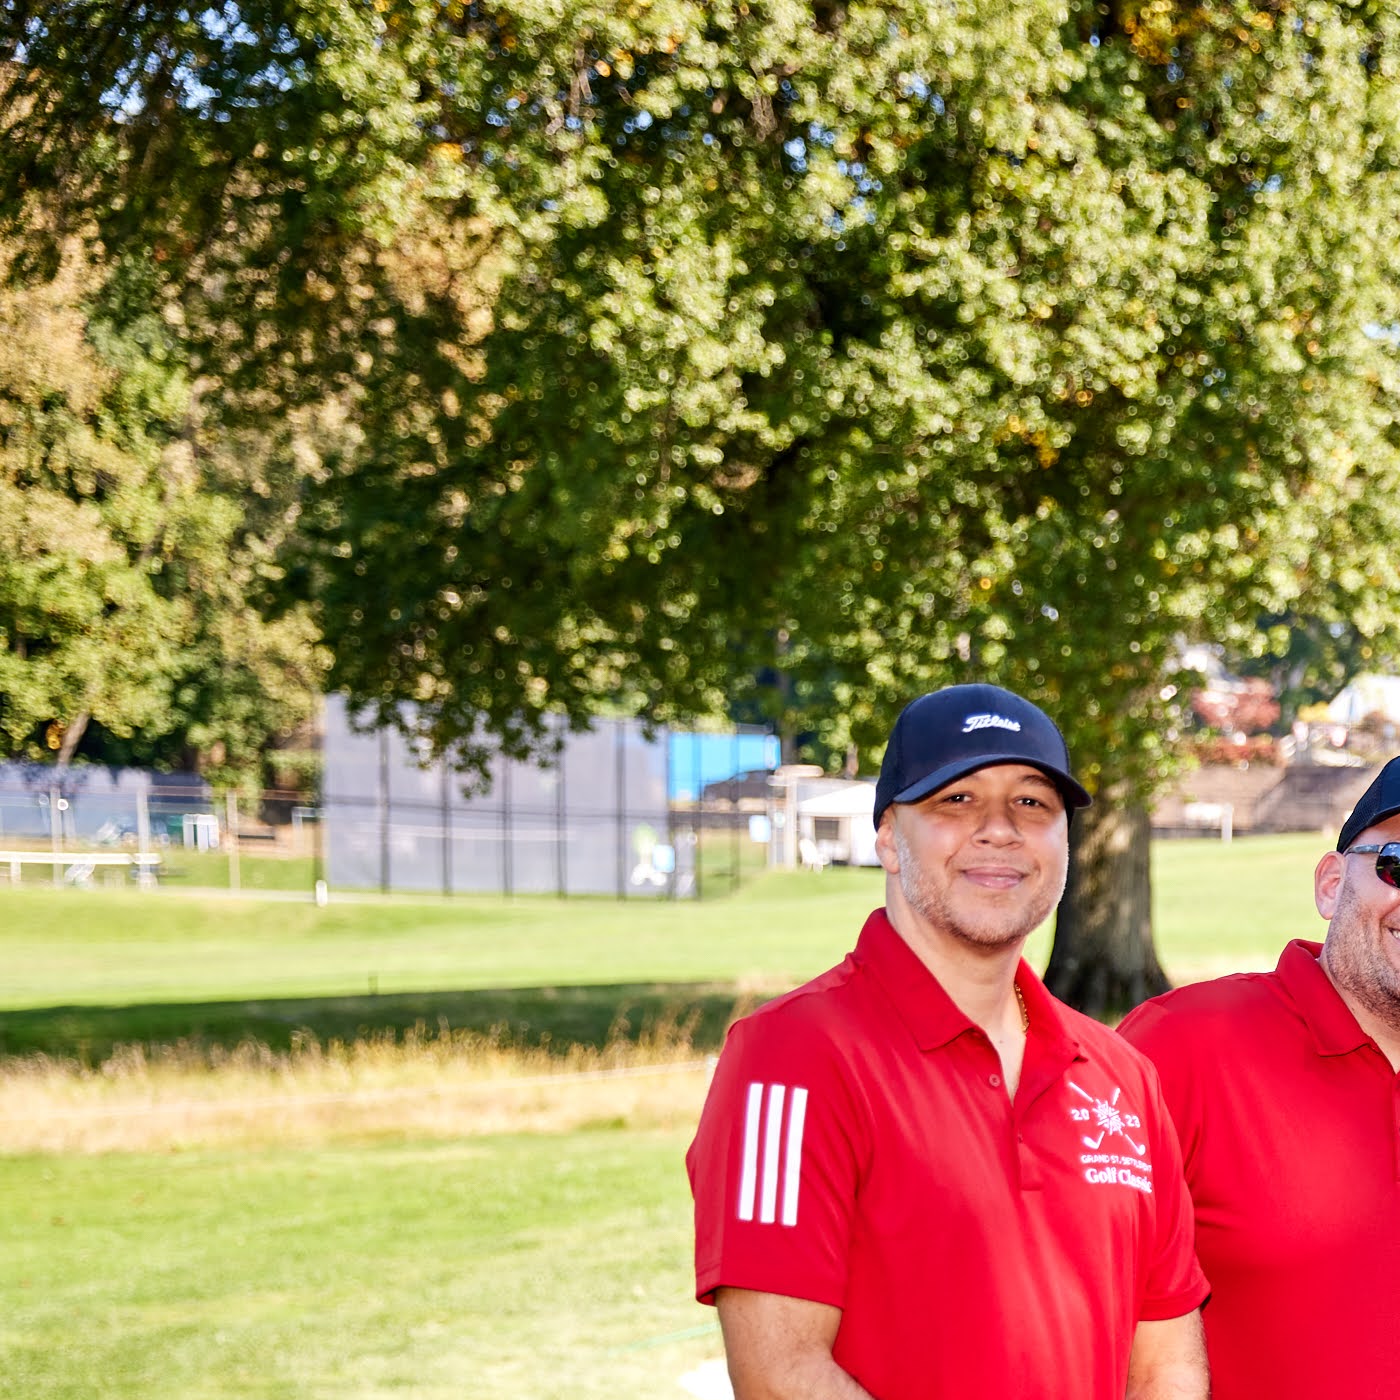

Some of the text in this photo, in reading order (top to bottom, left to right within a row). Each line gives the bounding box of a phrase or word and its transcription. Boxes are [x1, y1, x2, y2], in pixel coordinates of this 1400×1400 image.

[1070, 1108, 1090, 1120] 20
[1081, 1154, 1109, 1164] GRAND
[1085, 1167, 1153, 1193] Golf Classic
